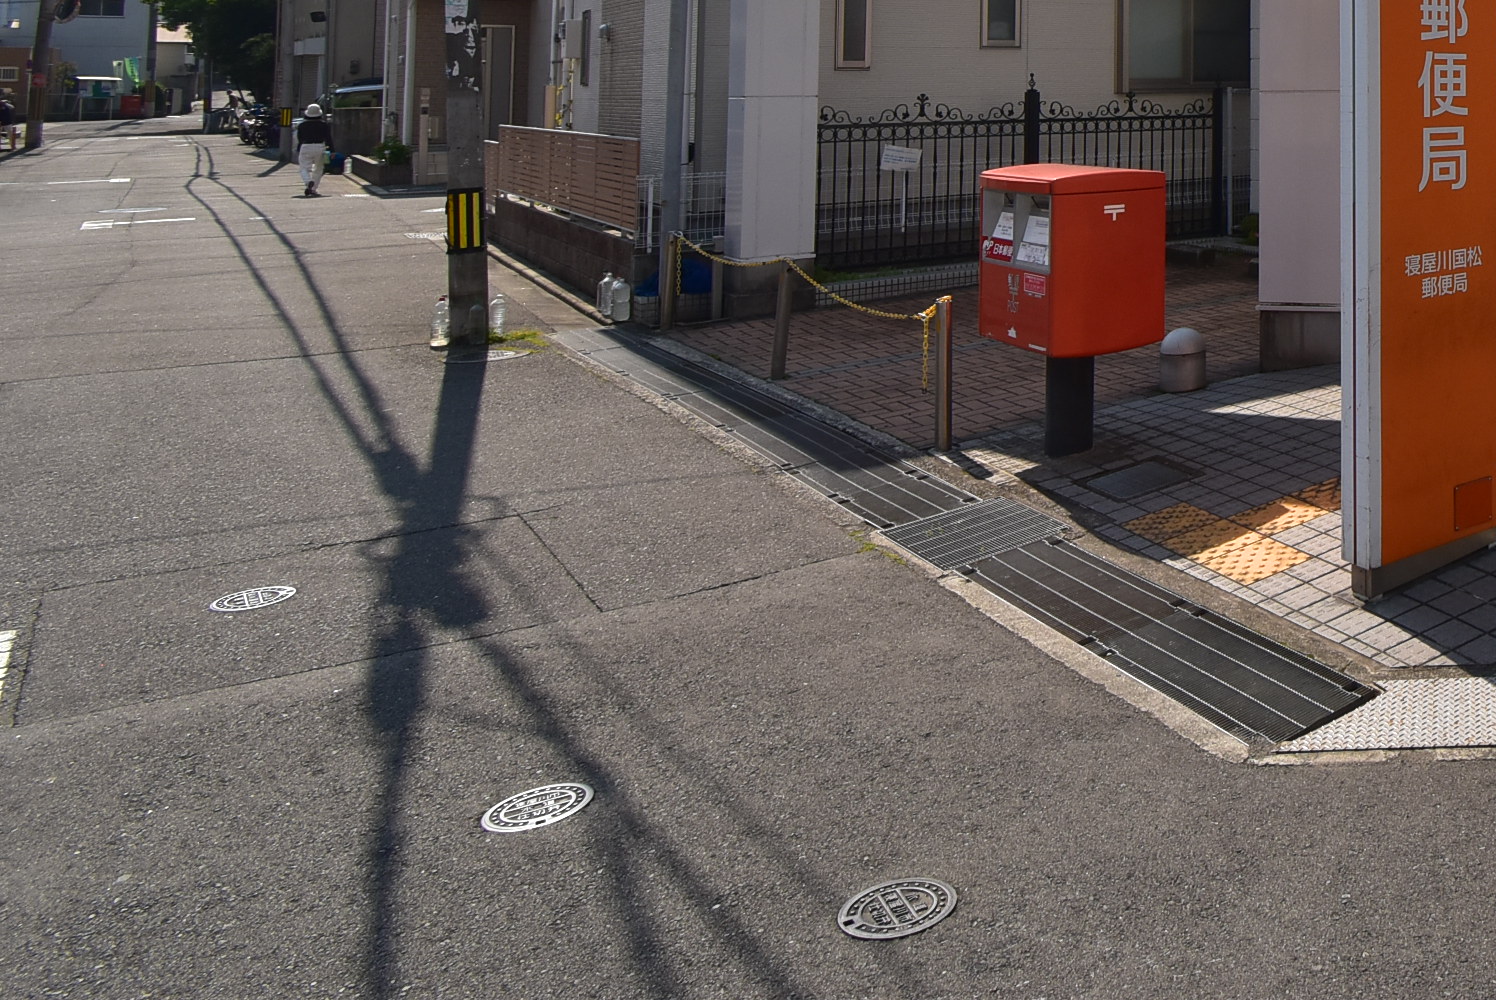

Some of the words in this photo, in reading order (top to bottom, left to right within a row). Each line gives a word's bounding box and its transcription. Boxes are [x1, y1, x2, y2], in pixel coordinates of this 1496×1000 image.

[1405, 245, 1483, 277] 寝屋川国松
[1421, 272, 1468, 299] 郵便局
